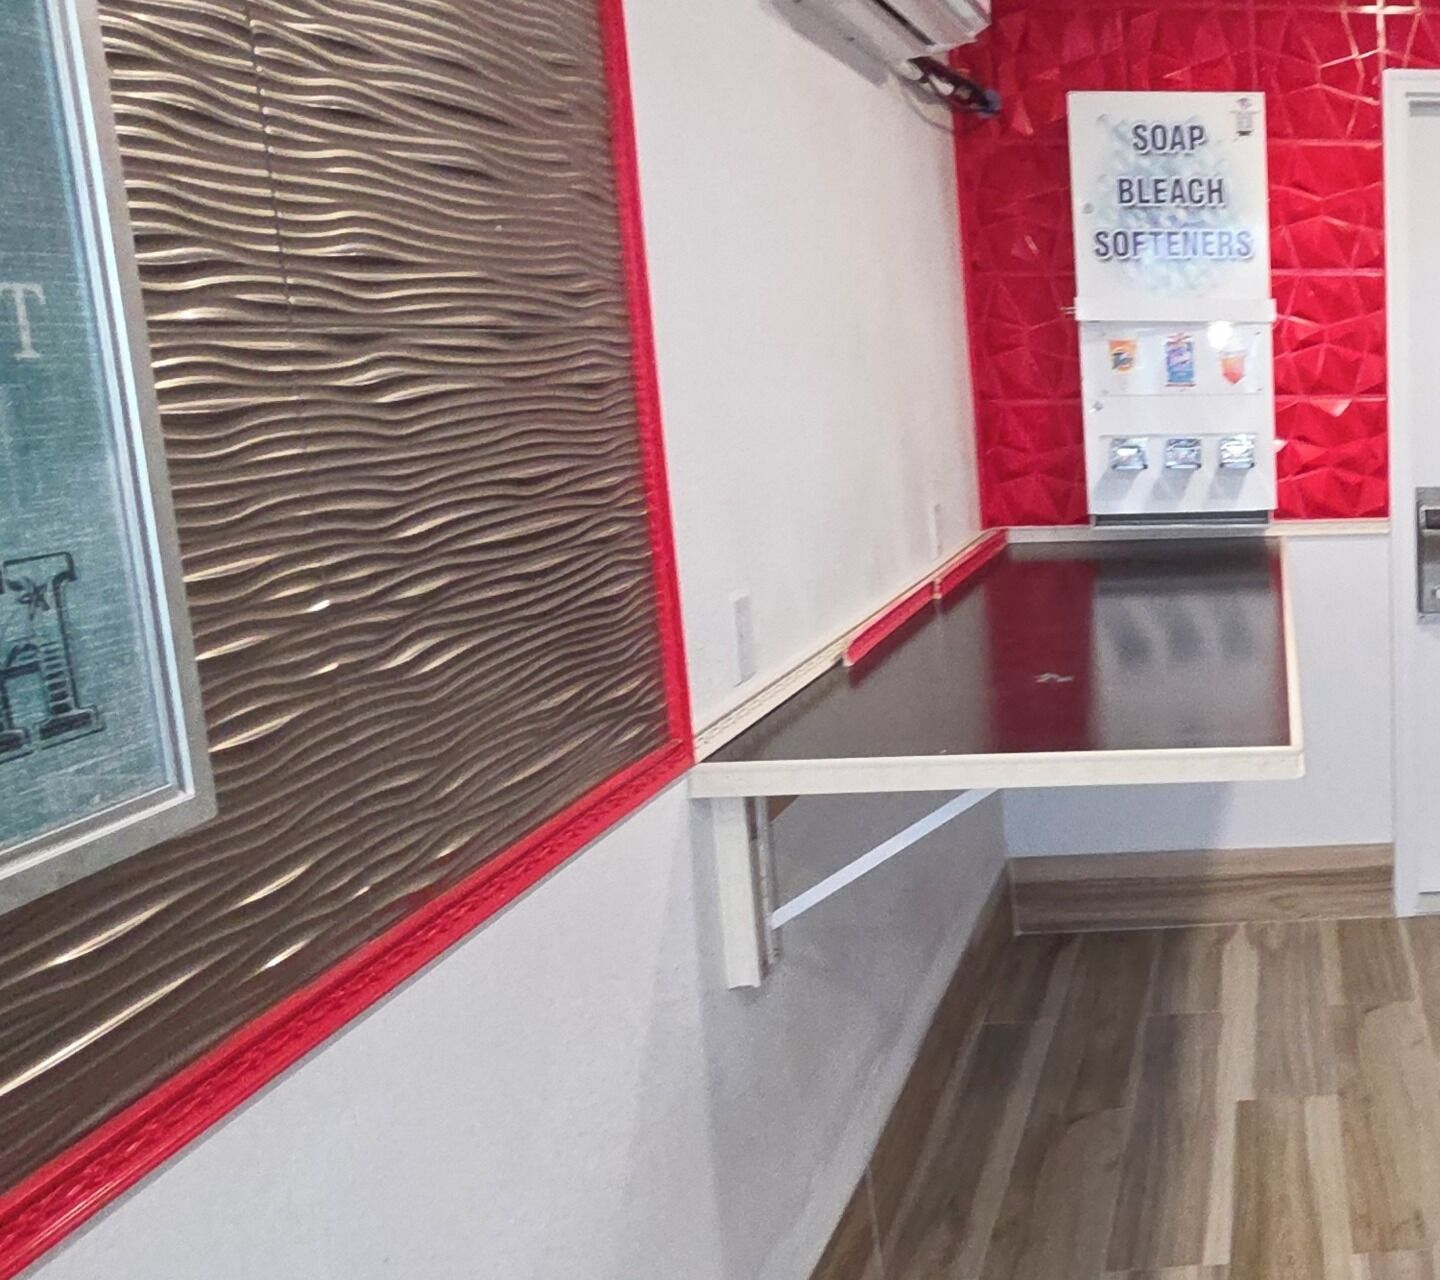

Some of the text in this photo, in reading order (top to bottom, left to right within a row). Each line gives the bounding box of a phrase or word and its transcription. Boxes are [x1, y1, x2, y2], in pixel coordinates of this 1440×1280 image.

[1132, 123, 1206, 154] SOAP
[1117, 177, 1225, 206] BLEACH
[1093, 230, 1253, 260] SOFTENERS
